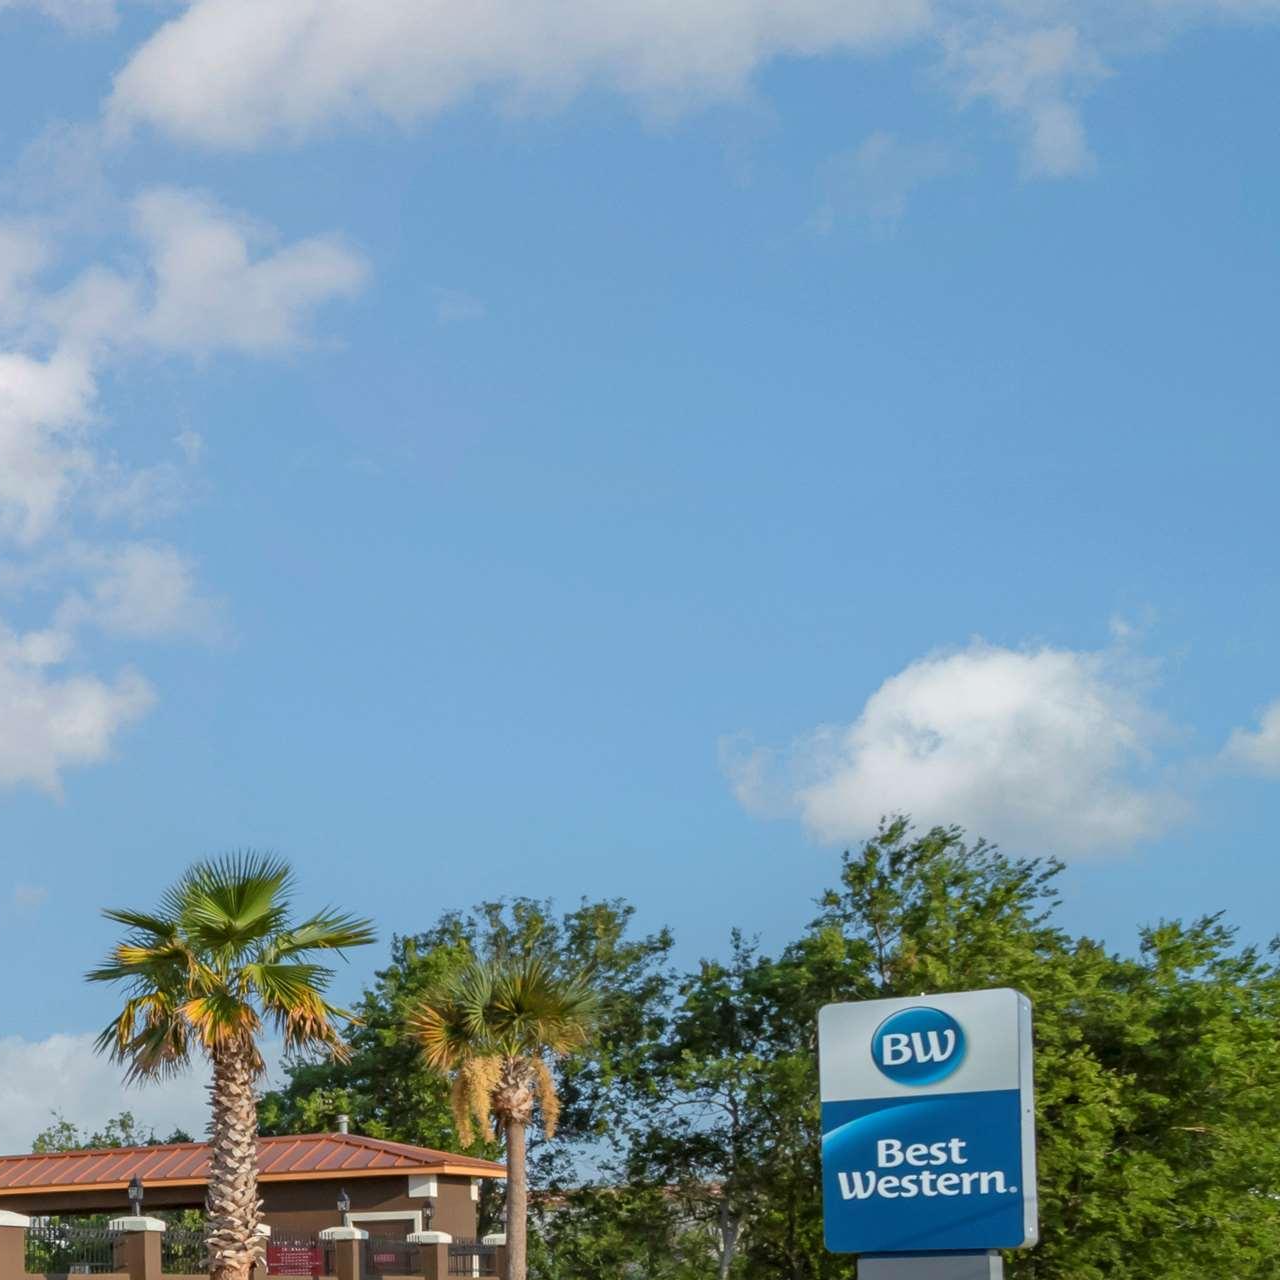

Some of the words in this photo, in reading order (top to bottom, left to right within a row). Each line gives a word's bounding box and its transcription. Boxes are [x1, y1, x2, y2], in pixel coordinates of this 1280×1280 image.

[882, 1028, 955, 1066] BW
[877, 1138, 968, 1168] Best
[838, 1170, 1007, 1200] Western
